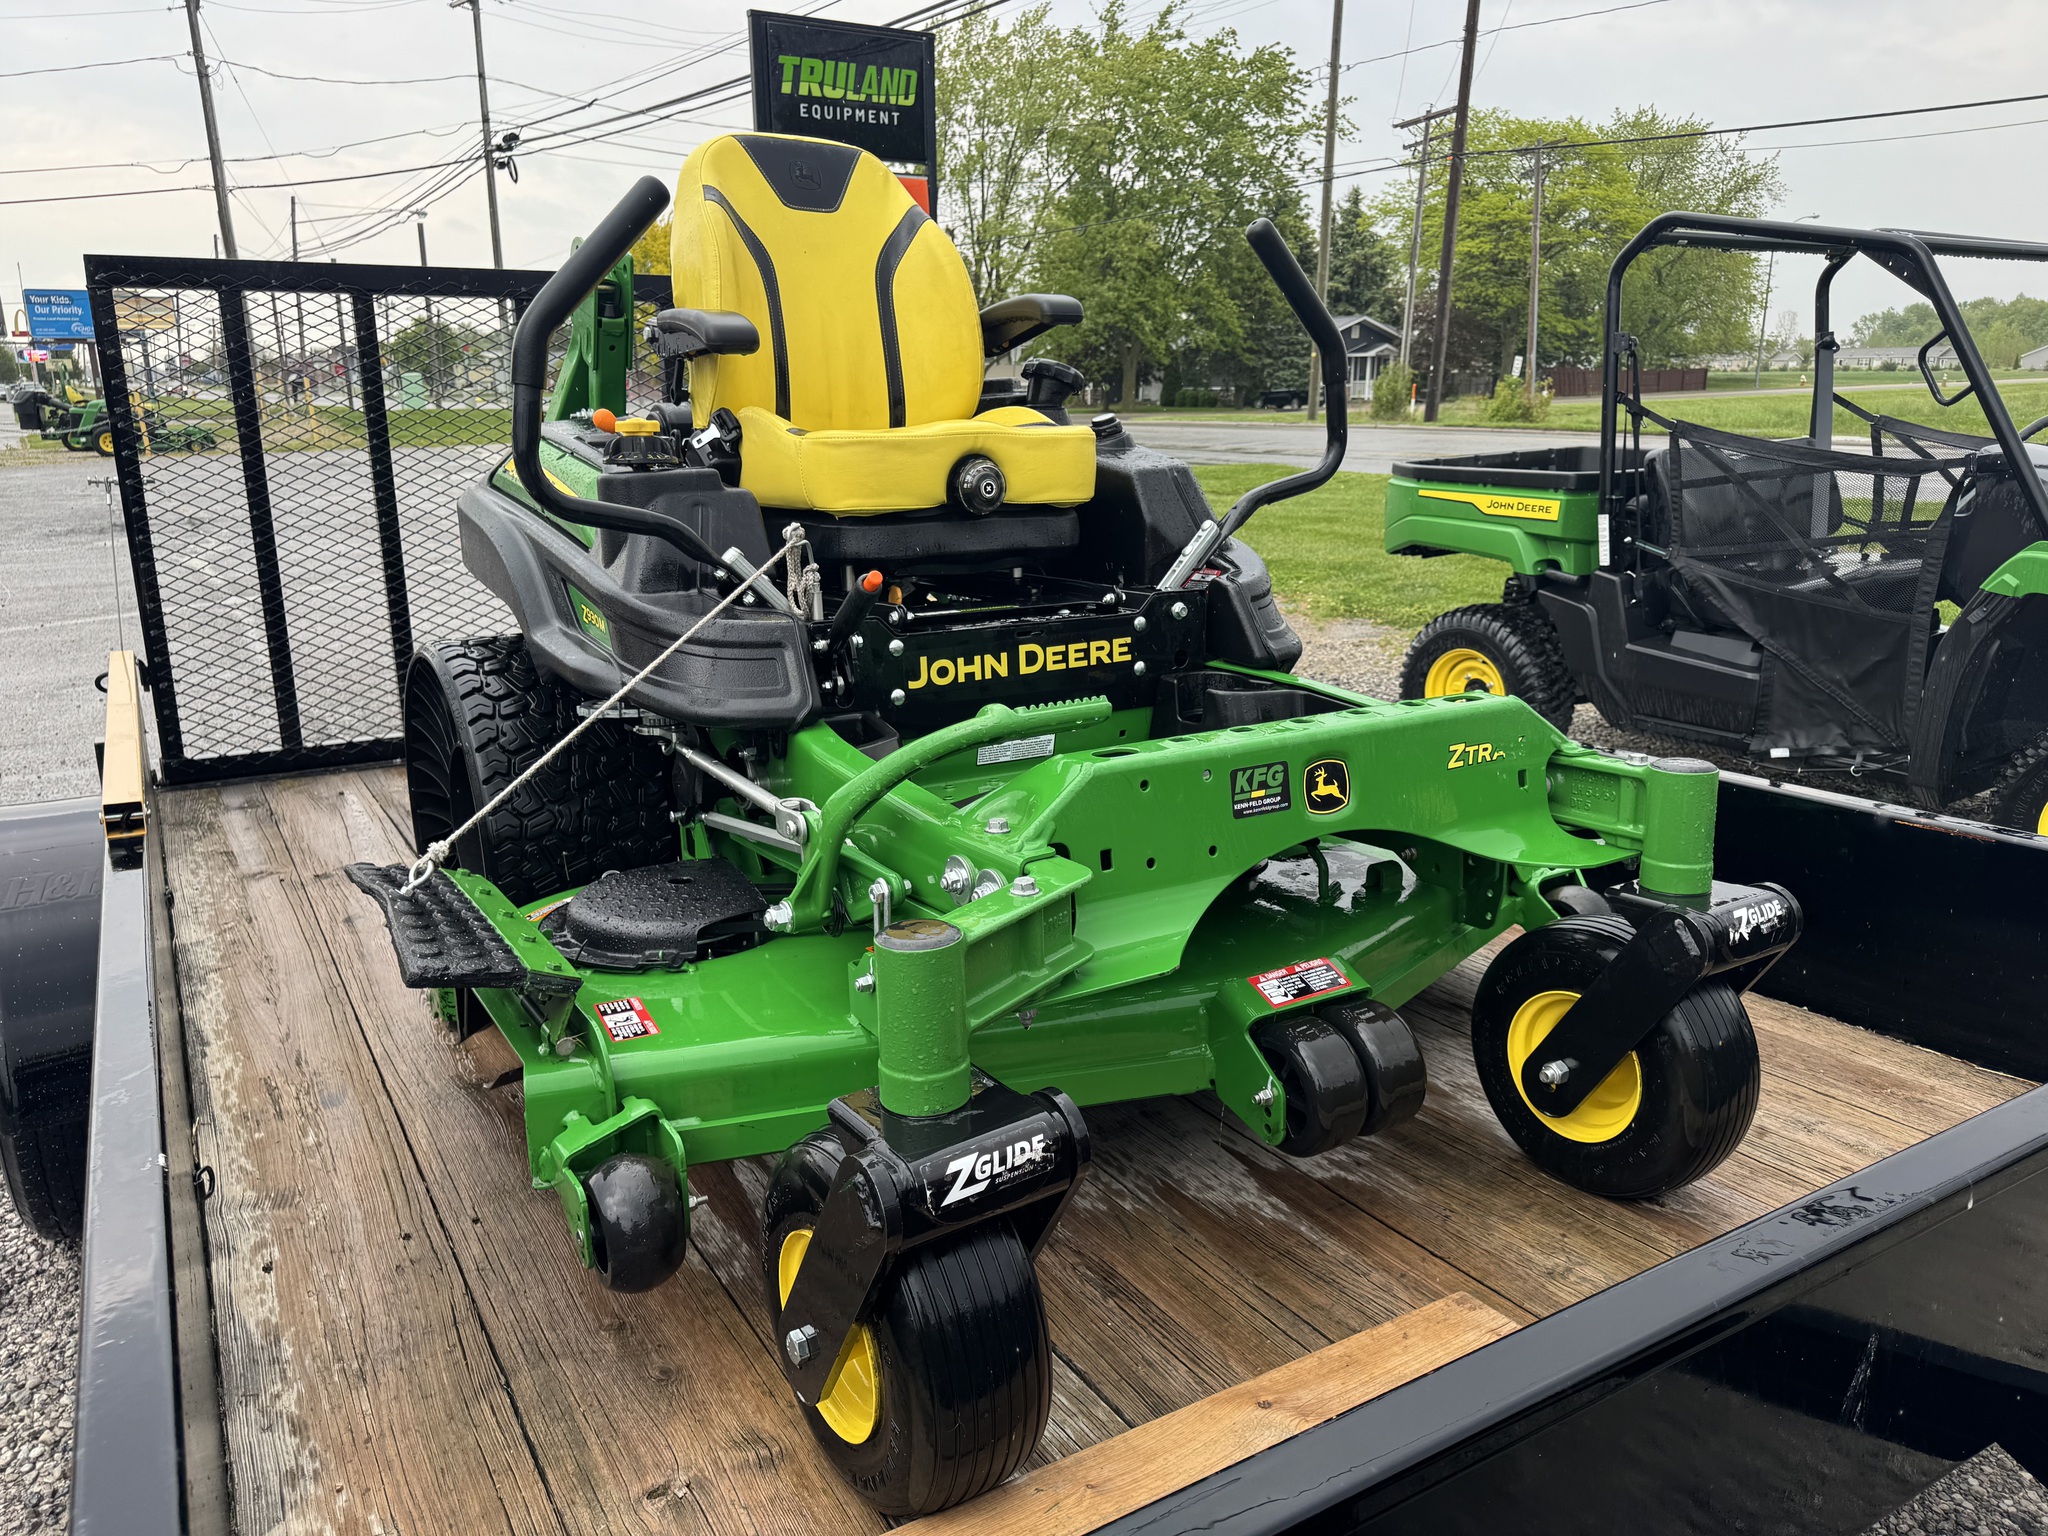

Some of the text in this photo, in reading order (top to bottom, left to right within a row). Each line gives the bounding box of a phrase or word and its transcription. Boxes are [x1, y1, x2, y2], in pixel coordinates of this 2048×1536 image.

[778, 55, 918, 106] TRULAND
[800, 103, 900, 125] EQUIPMENT
[29, 295, 72, 304] Your Kids.
[34, 305, 84, 316] Our Priority.
[1486, 499, 1552, 514] JOHN DEERE
[908, 636, 1132, 690] JOHN DEERE
[1235, 764, 1285, 794] KFG
[1234, 796, 1282, 810] KENN-FELD GROUP
[1264, 968, 1288, 980] DANGER
